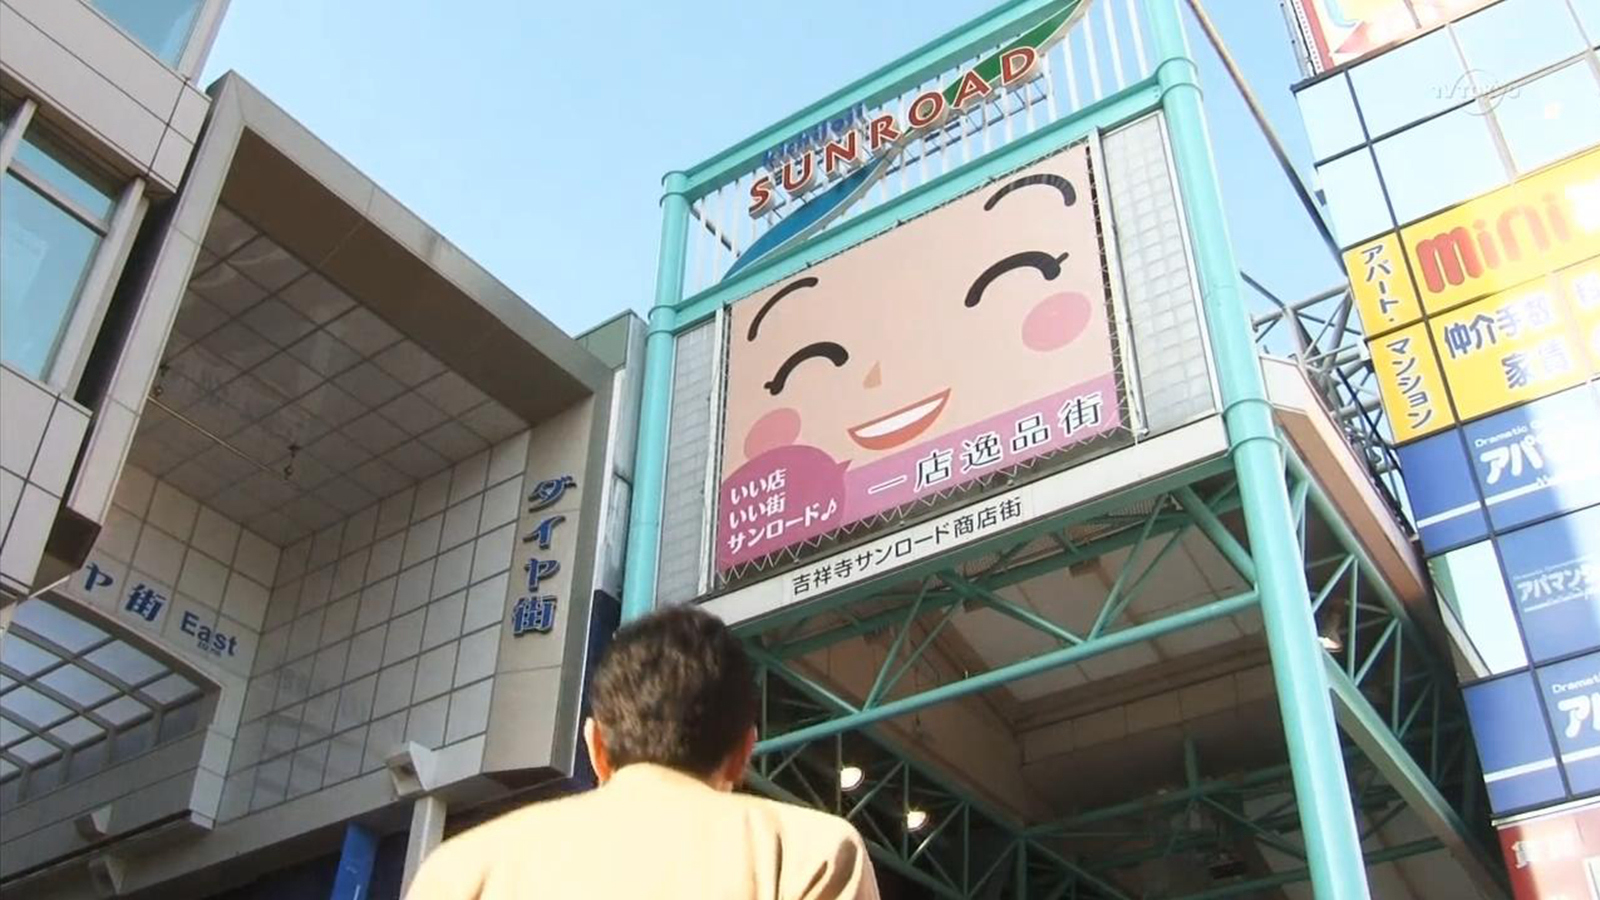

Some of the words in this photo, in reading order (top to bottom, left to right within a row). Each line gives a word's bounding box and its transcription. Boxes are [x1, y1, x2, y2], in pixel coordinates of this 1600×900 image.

[749, 46, 1037, 219] SUNROAD
[1386, 338, 1432, 429] マンション
[868, 391, 1102, 493] 一店逸品街
[1475, 426, 1528, 447] Dramatic
[729, 492, 786, 529] いい街
[730, 468, 787, 505] いい店
[512, 475, 577, 638] ダイヤ街
[793, 496, 1022, 595] 吉祥寺サンロード商店街
[180, 611, 238, 656] East
